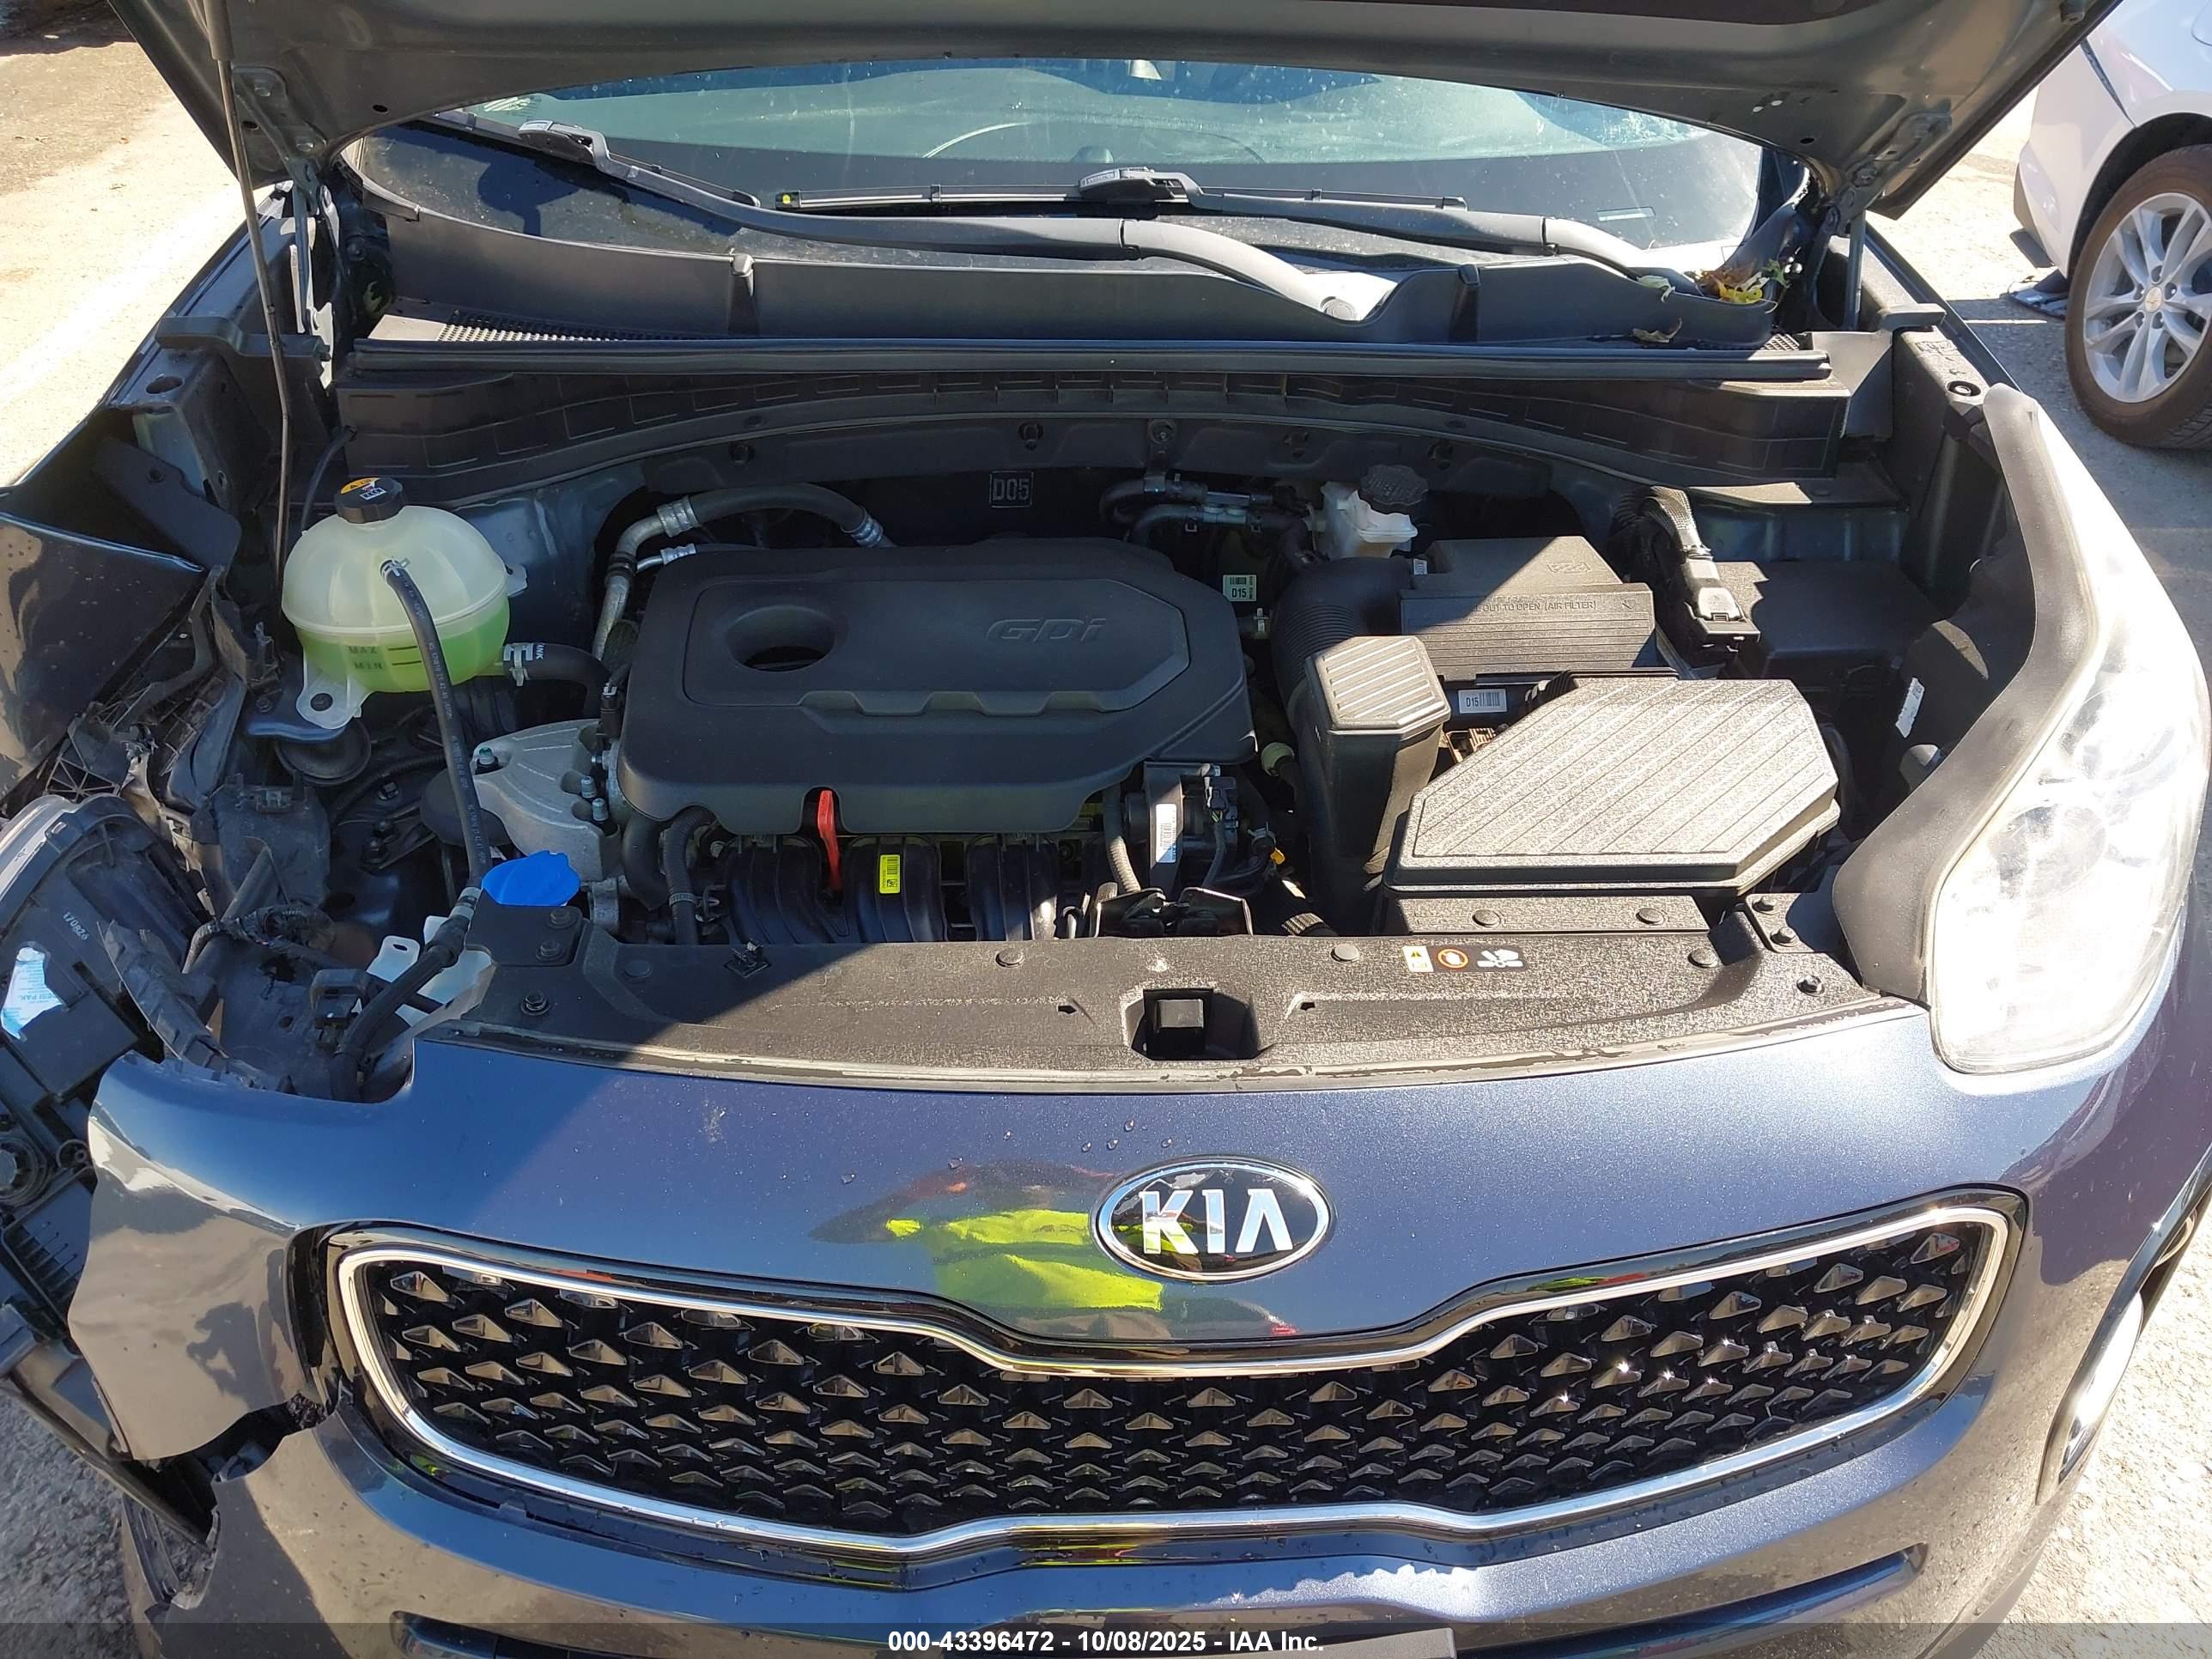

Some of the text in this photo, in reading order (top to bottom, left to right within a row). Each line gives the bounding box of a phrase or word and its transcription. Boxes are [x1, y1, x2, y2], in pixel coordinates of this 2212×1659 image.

[993, 478, 1030, 501] D05
[1231, 587, 1247, 599] D15
[1504, 603, 1515, 611] TO
[1516, 602, 1540, 611] OPEN
[988, 617, 1107, 642] GDi
[347, 645, 378, 654] MAX
[1139, 1188, 1293, 1254] KIA
